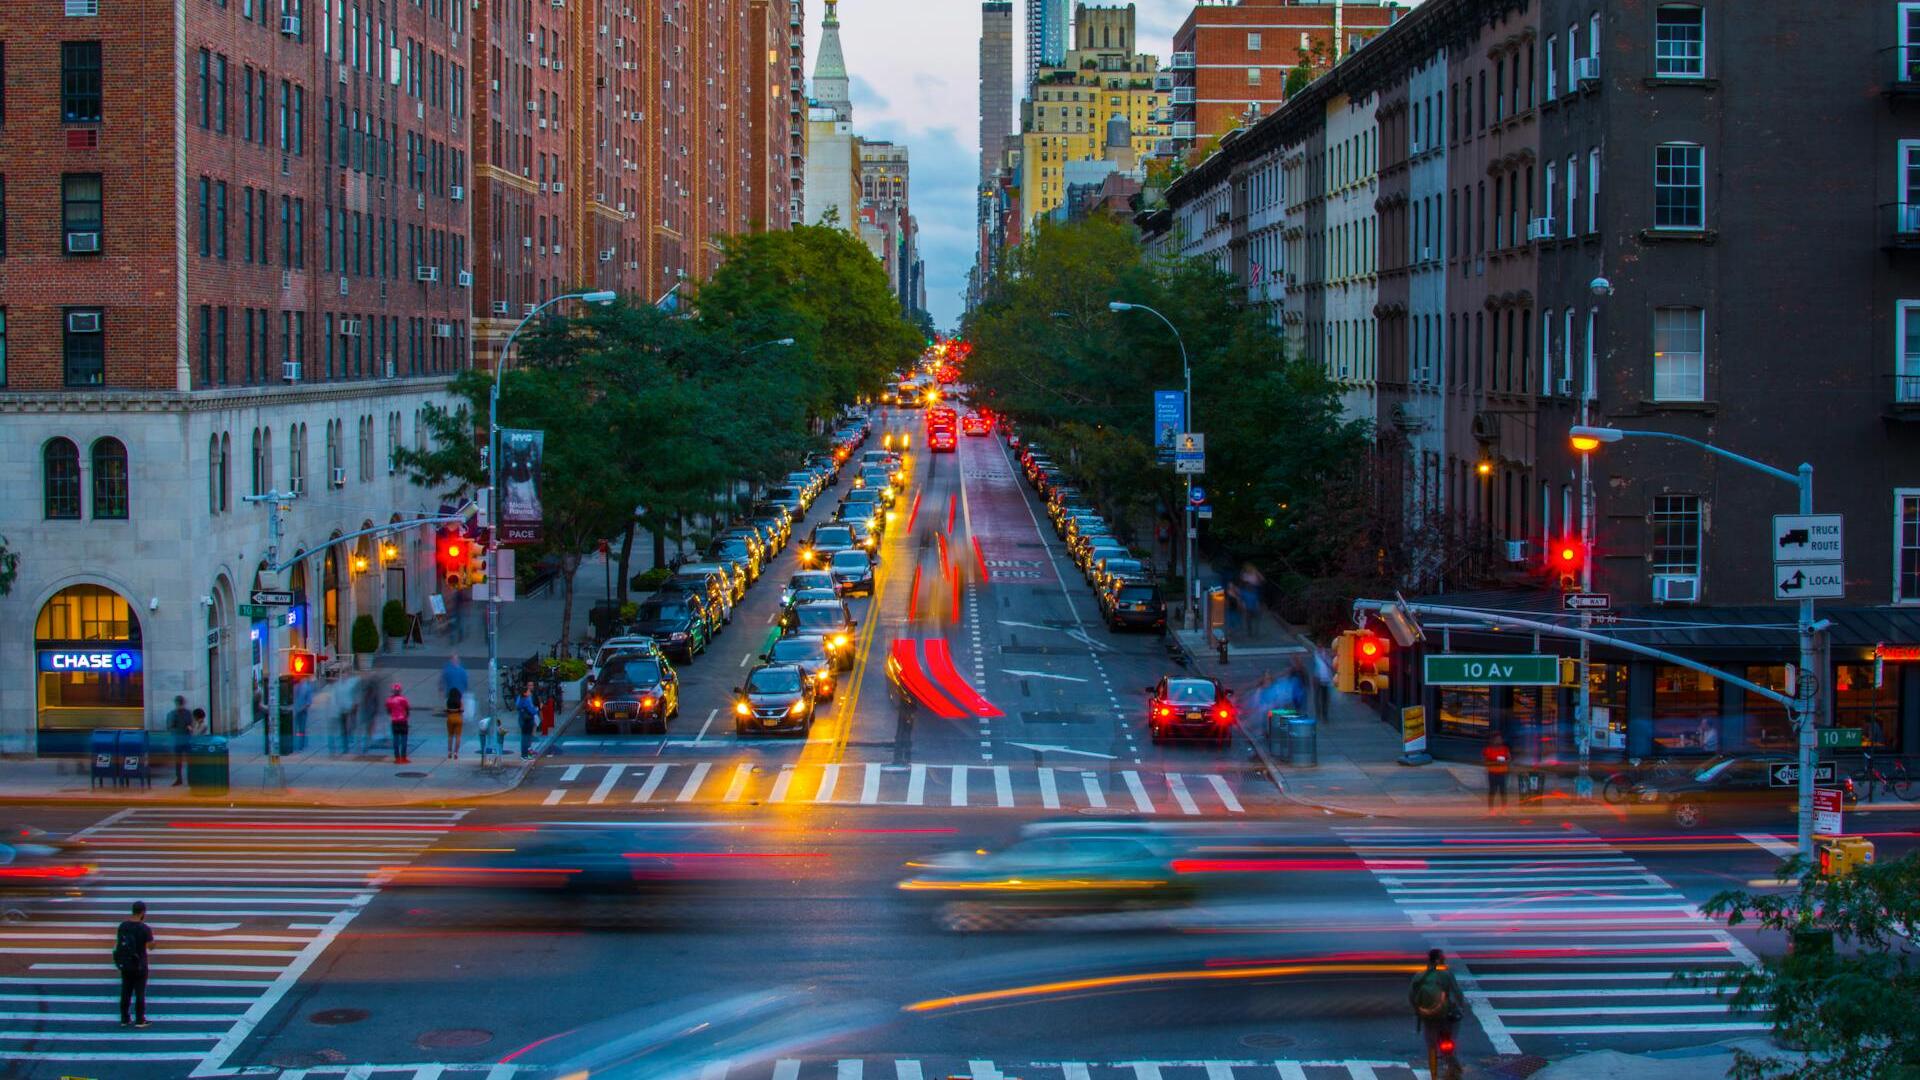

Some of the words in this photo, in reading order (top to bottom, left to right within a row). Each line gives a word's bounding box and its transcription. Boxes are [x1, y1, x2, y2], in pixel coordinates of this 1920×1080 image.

[511, 433, 532, 442] NYC
[509, 530, 535, 538] PACE
[1811, 526, 1838, 535] TRUCK
[1811, 542, 1839, 550] ROUTE
[1809, 576, 1840, 585] LOCAL
[53, 654, 112, 668] CHASE
[1463, 663, 1482, 677] 10
[1488, 663, 1513, 677] Av
[1824, 731, 1838, 745] 10
[1780, 769, 1799, 779] ONE
